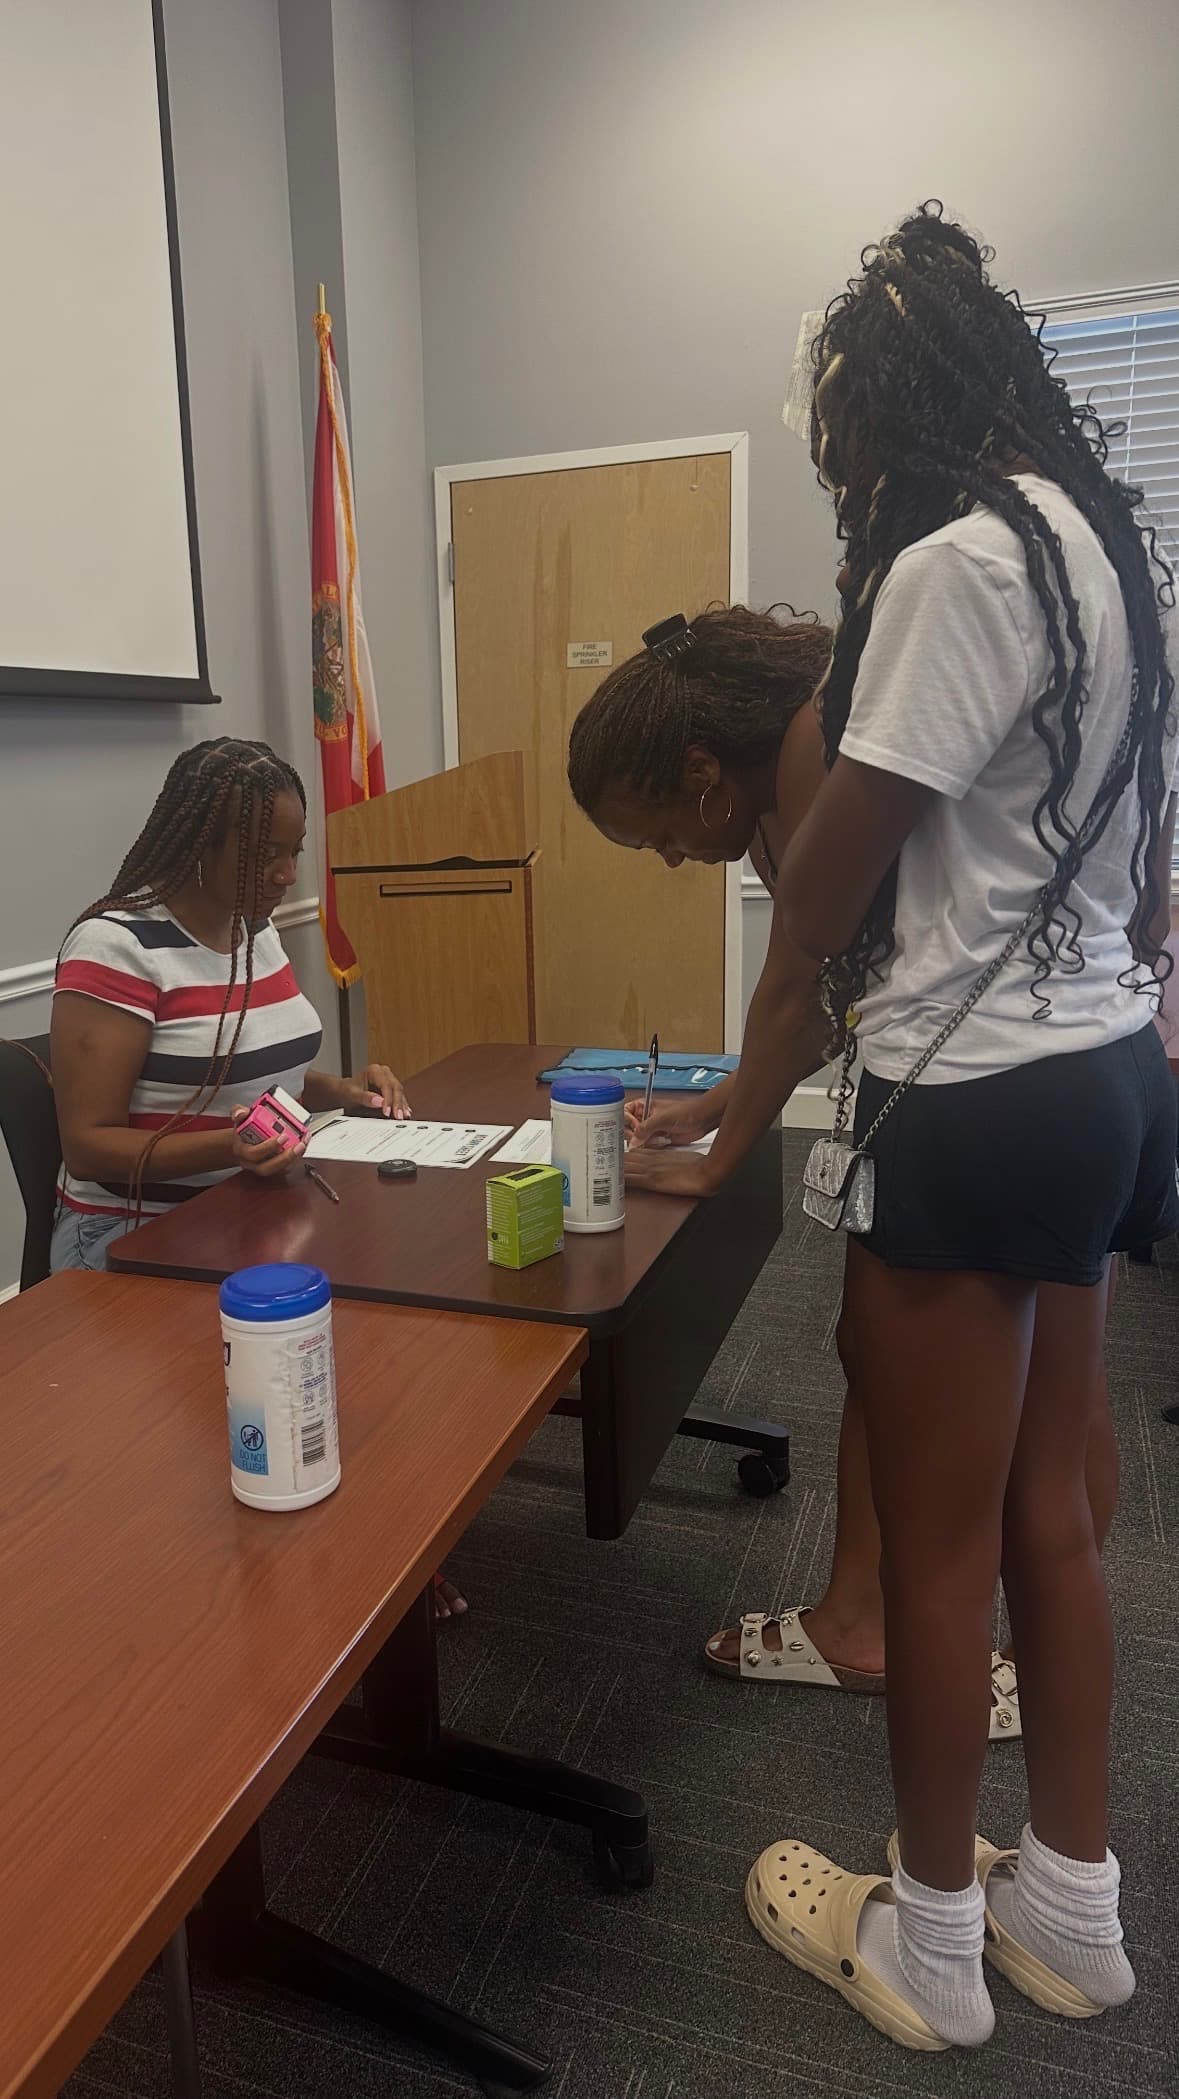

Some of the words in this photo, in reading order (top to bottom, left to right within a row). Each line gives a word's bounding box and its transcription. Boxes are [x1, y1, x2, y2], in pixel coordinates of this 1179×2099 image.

[572, 650, 608, 658] SPRINKLER
[239, 1448, 250, 1460] DO
[250, 1452, 266, 1462] NOT
[243, 1459, 266, 1473] FLUSH
